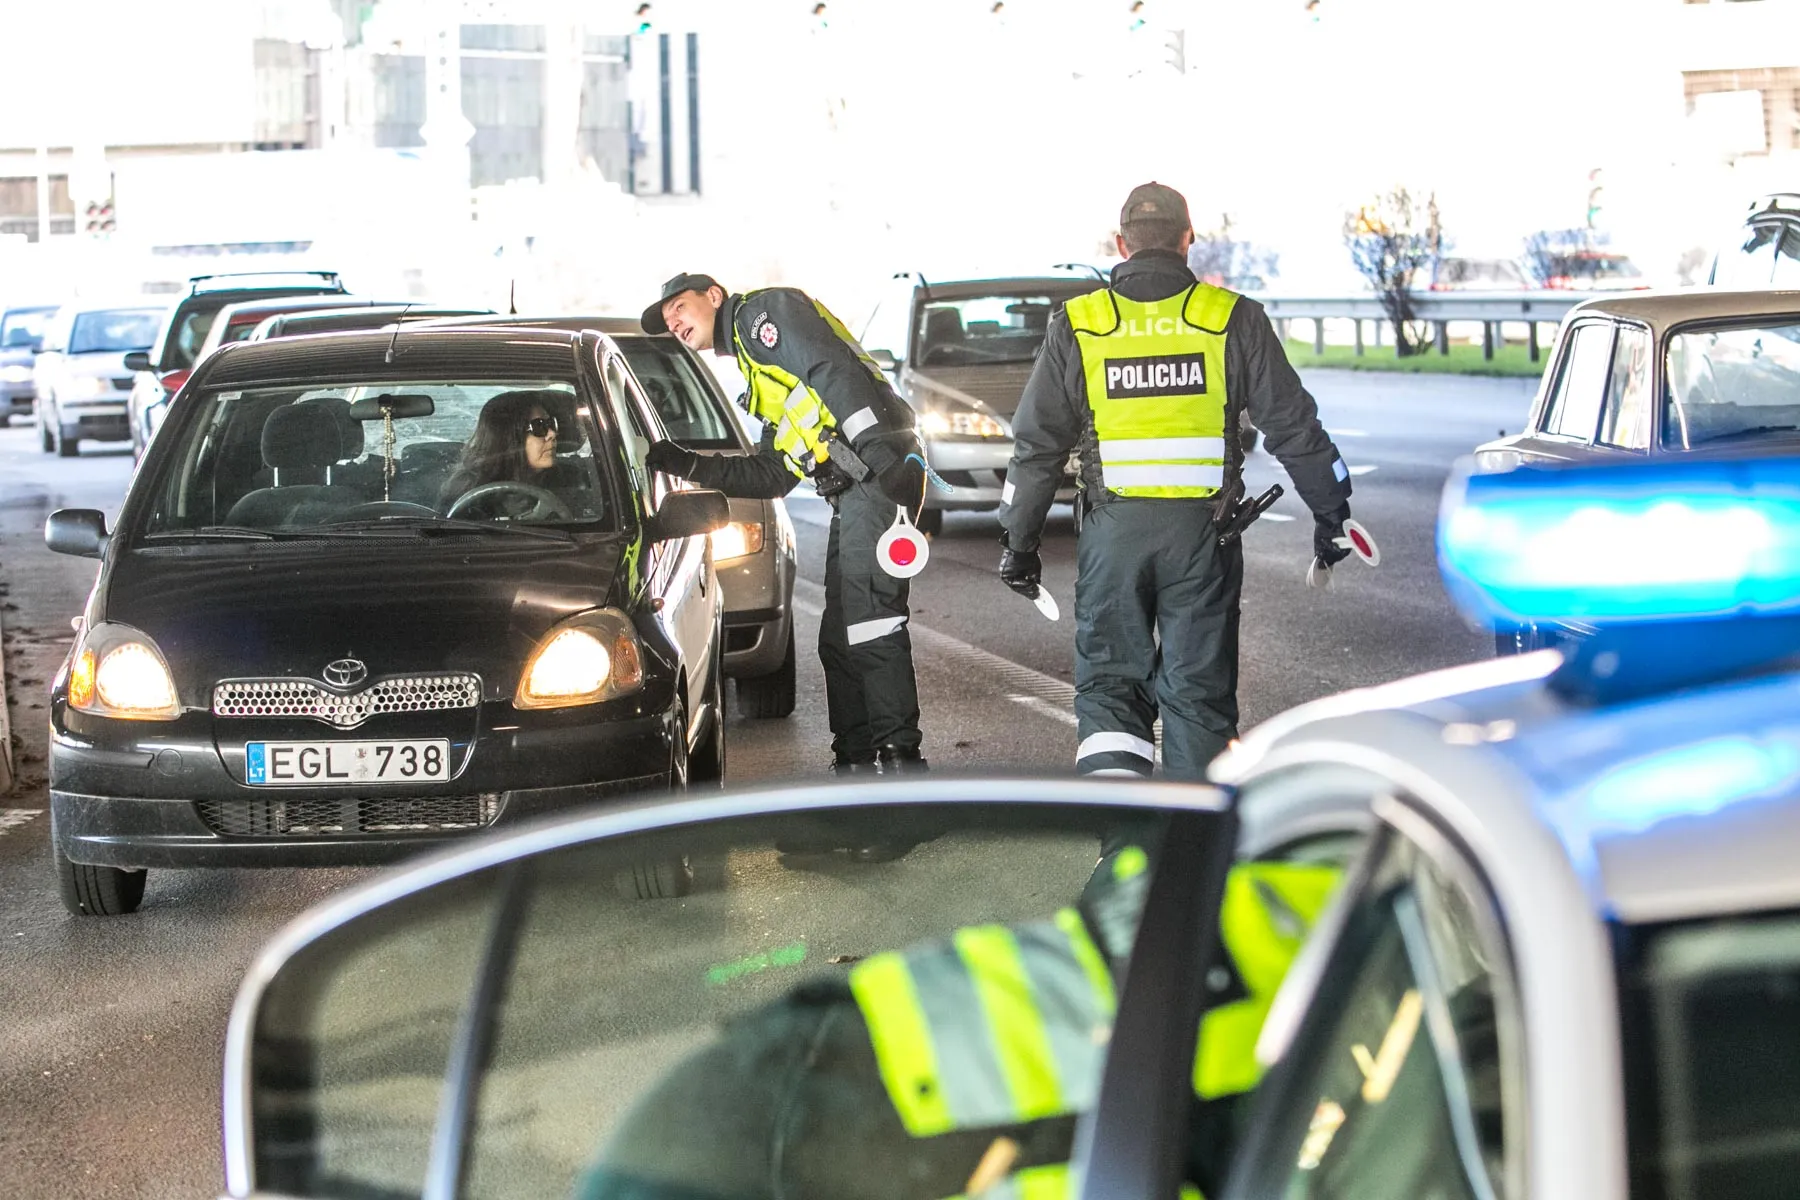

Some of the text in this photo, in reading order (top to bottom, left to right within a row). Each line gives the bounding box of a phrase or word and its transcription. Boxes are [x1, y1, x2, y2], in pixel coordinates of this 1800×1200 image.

[1107, 362, 1204, 390] POLICIJA
[249, 767, 265, 778] LT
[271, 745, 442, 779] EGL 738
